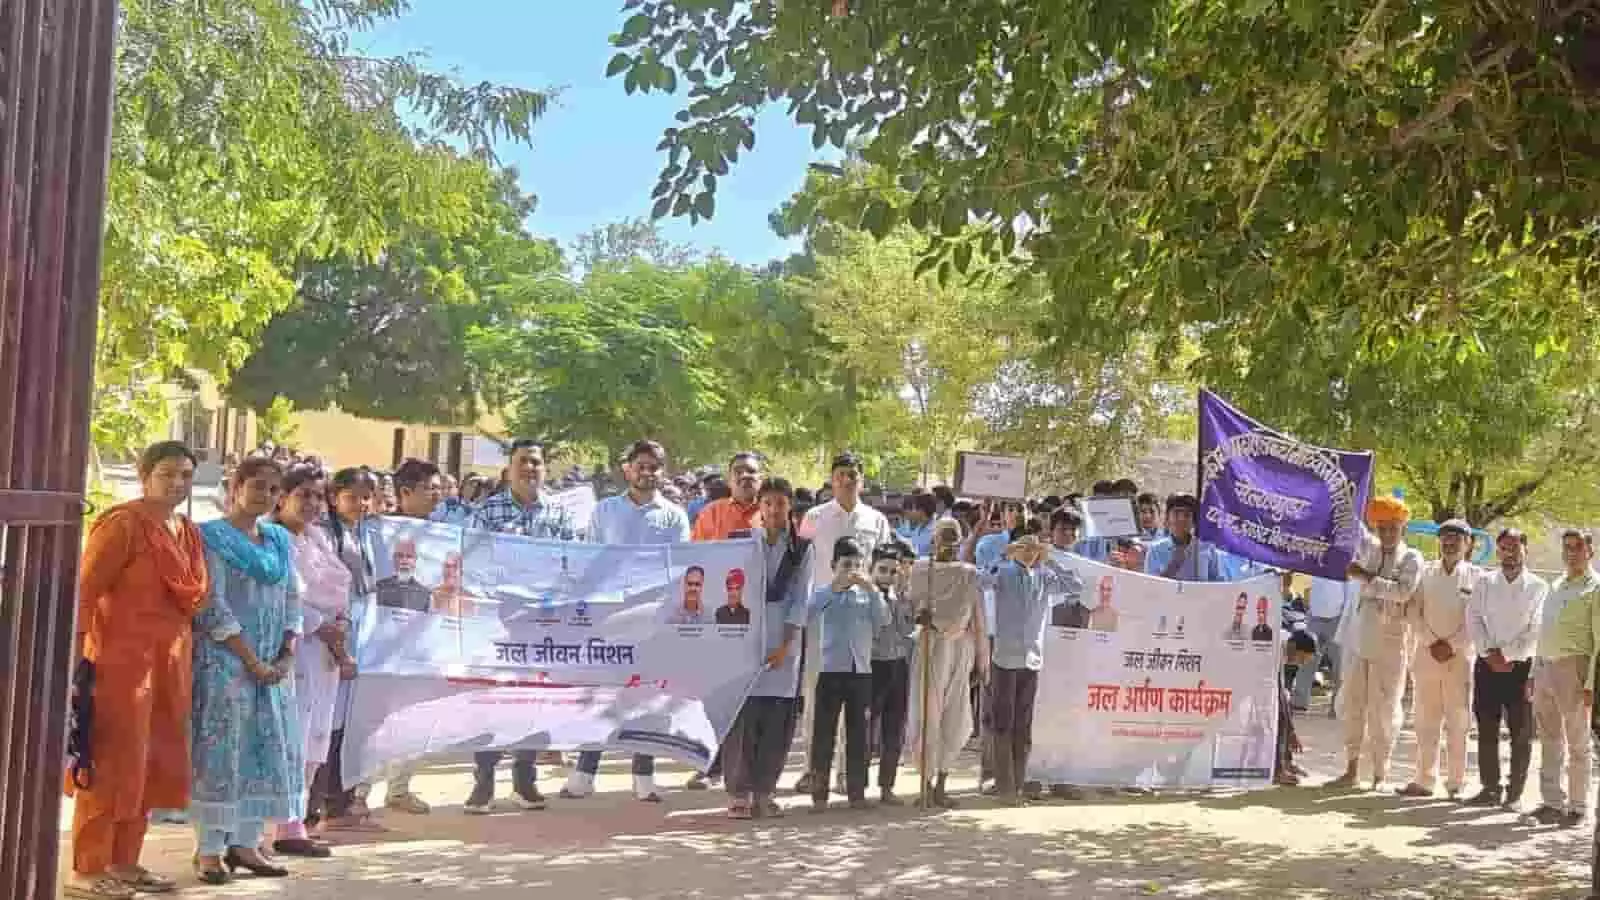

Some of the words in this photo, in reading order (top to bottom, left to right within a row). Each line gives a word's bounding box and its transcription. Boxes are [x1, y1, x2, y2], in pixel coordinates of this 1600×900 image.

[493, 640, 528, 664] जल
[531, 637, 582, 665] जीवन
[585, 638, 635, 665] मिशन
[1123, 650, 1145, 670] जल
[1147, 647, 1174, 672] जीवन
[1175, 648, 1203, 673] मिशन
[1087, 684, 1121, 713] जल
[1123, 676, 1165, 713] अर्पण
[1167, 679, 1233, 719] कार्यक्रम
